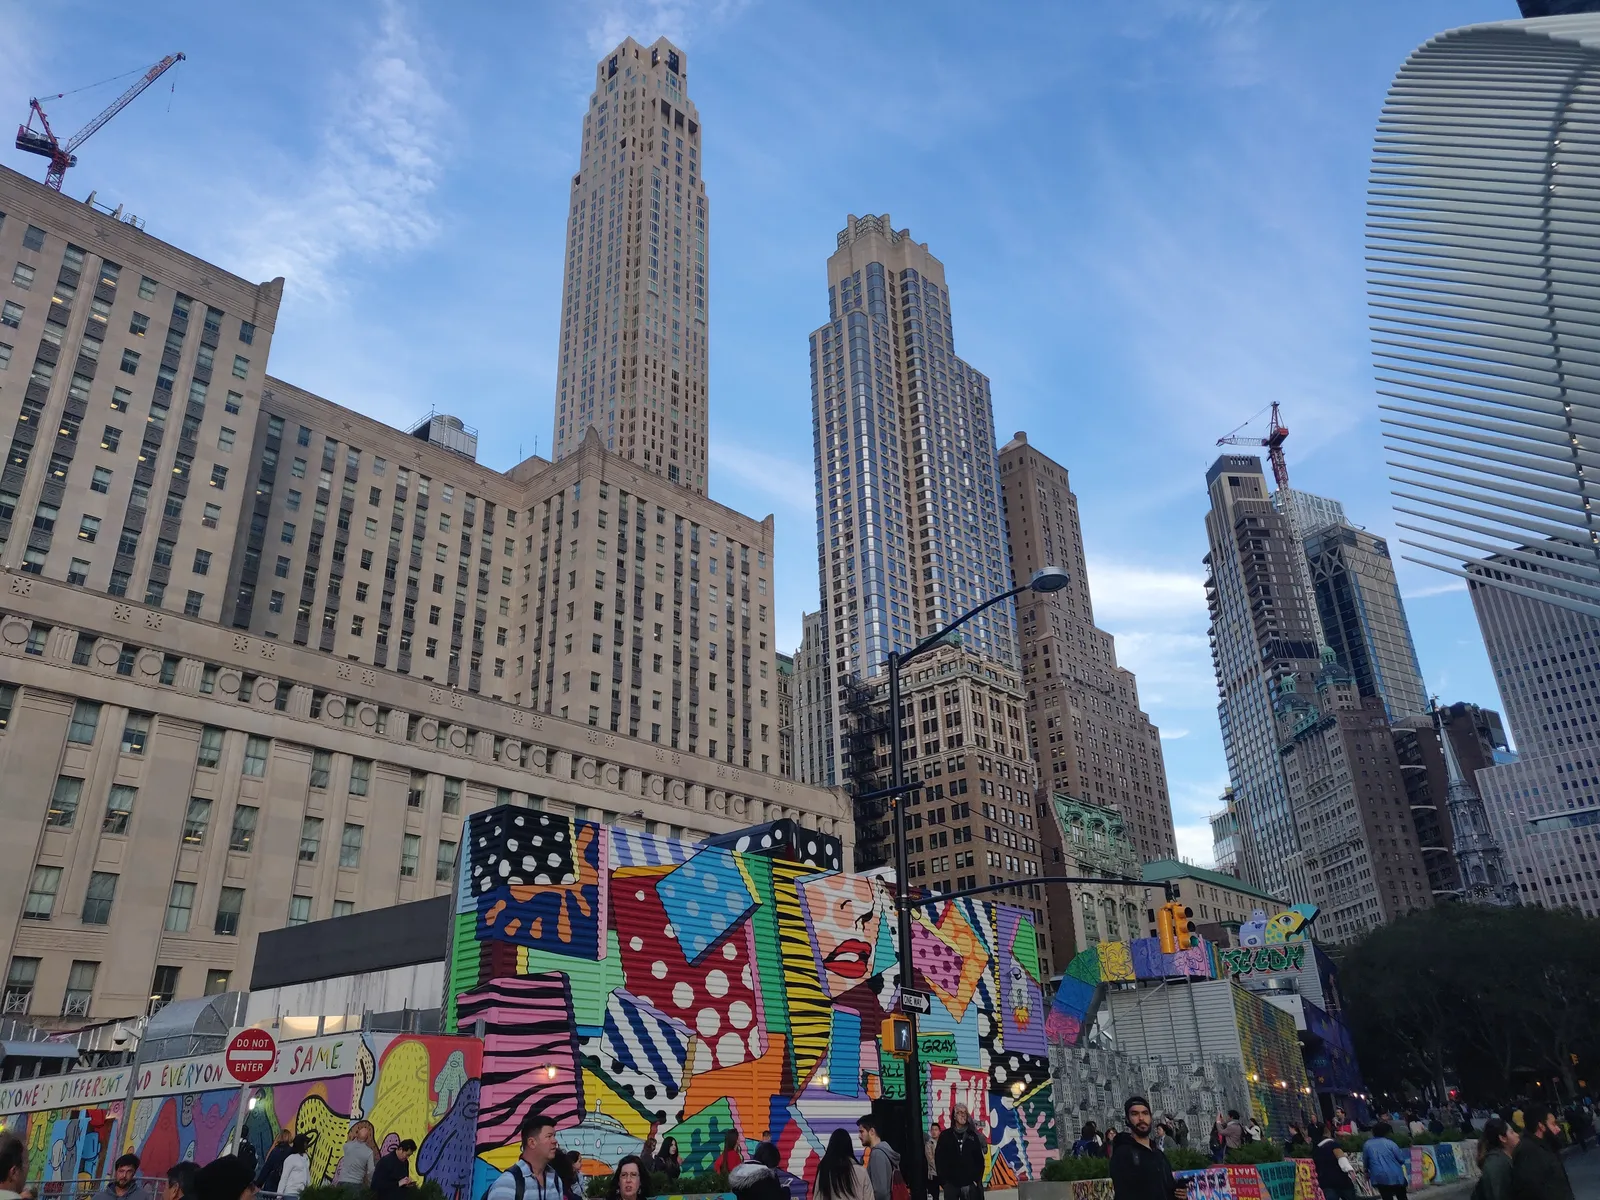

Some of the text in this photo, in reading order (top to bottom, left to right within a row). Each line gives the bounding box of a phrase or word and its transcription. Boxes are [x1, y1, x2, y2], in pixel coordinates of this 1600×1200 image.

[903, 995, 923, 1007] ONE WAY
[236, 1038, 270, 1048] DO NOT
[922, 1039, 956, 1053] GRAY
[235, 1062, 264, 1072] ENTER
[60, 1074, 124, 1102] DIFFERENT
[125, 1069, 152, 1092] ND
[160, 1062, 224, 1089] EVERYON
